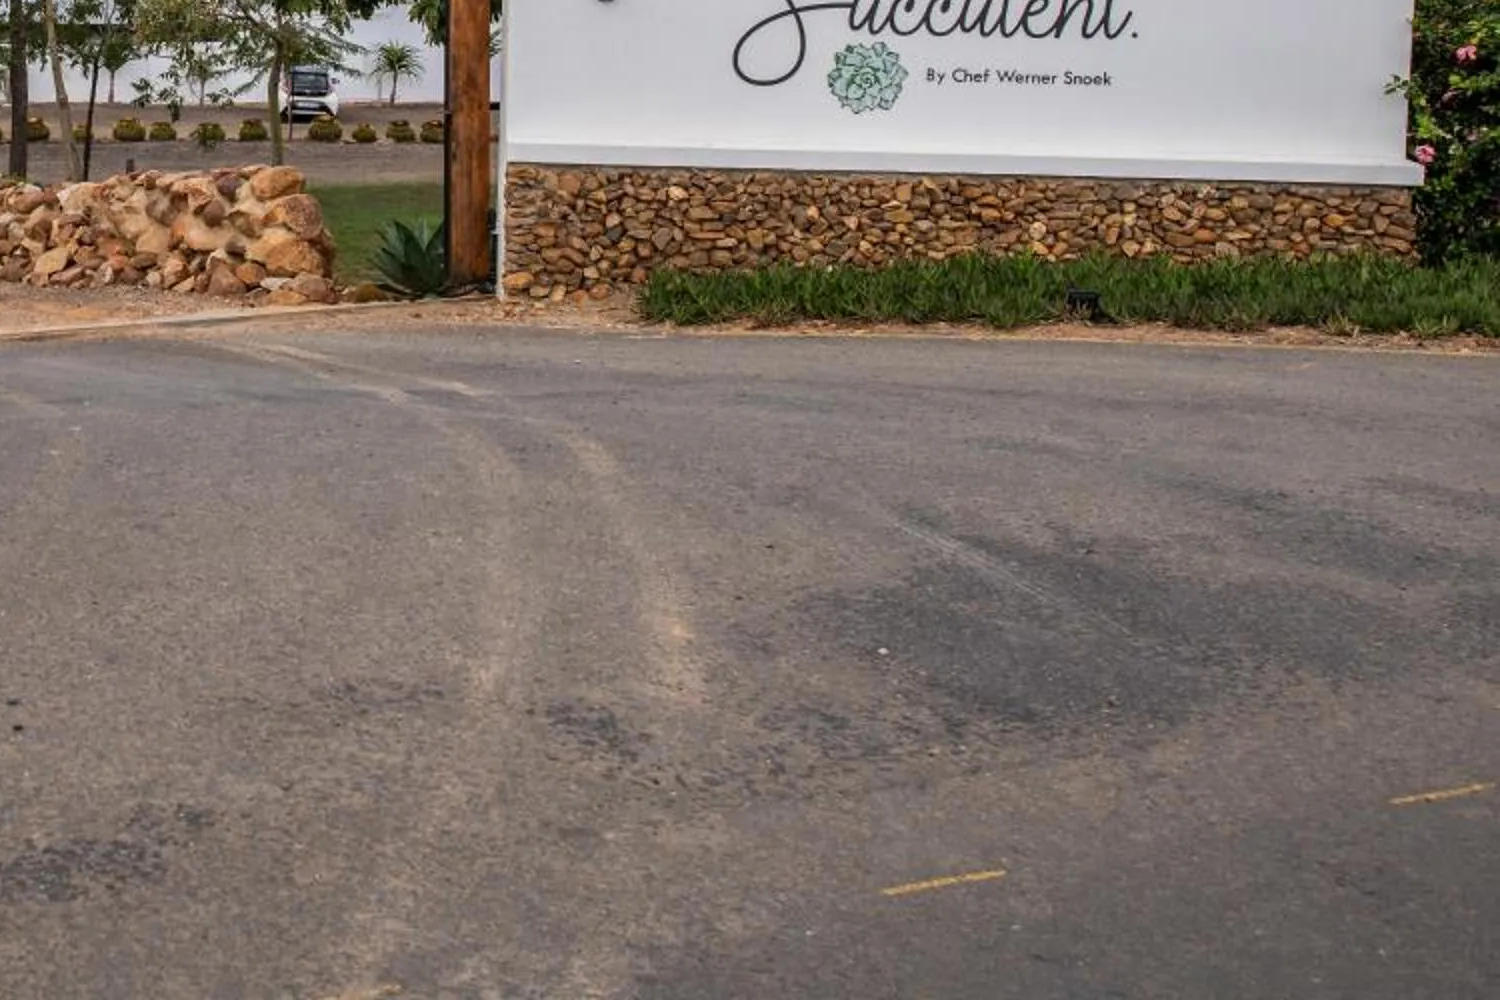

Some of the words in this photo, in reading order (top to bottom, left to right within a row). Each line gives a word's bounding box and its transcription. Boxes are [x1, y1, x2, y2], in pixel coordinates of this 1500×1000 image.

[926, 67, 946, 85] By
[951, 67, 990, 84] Chef
[995, 69, 1057, 86] Werner
[1062, 70, 1113, 87] Snoek
